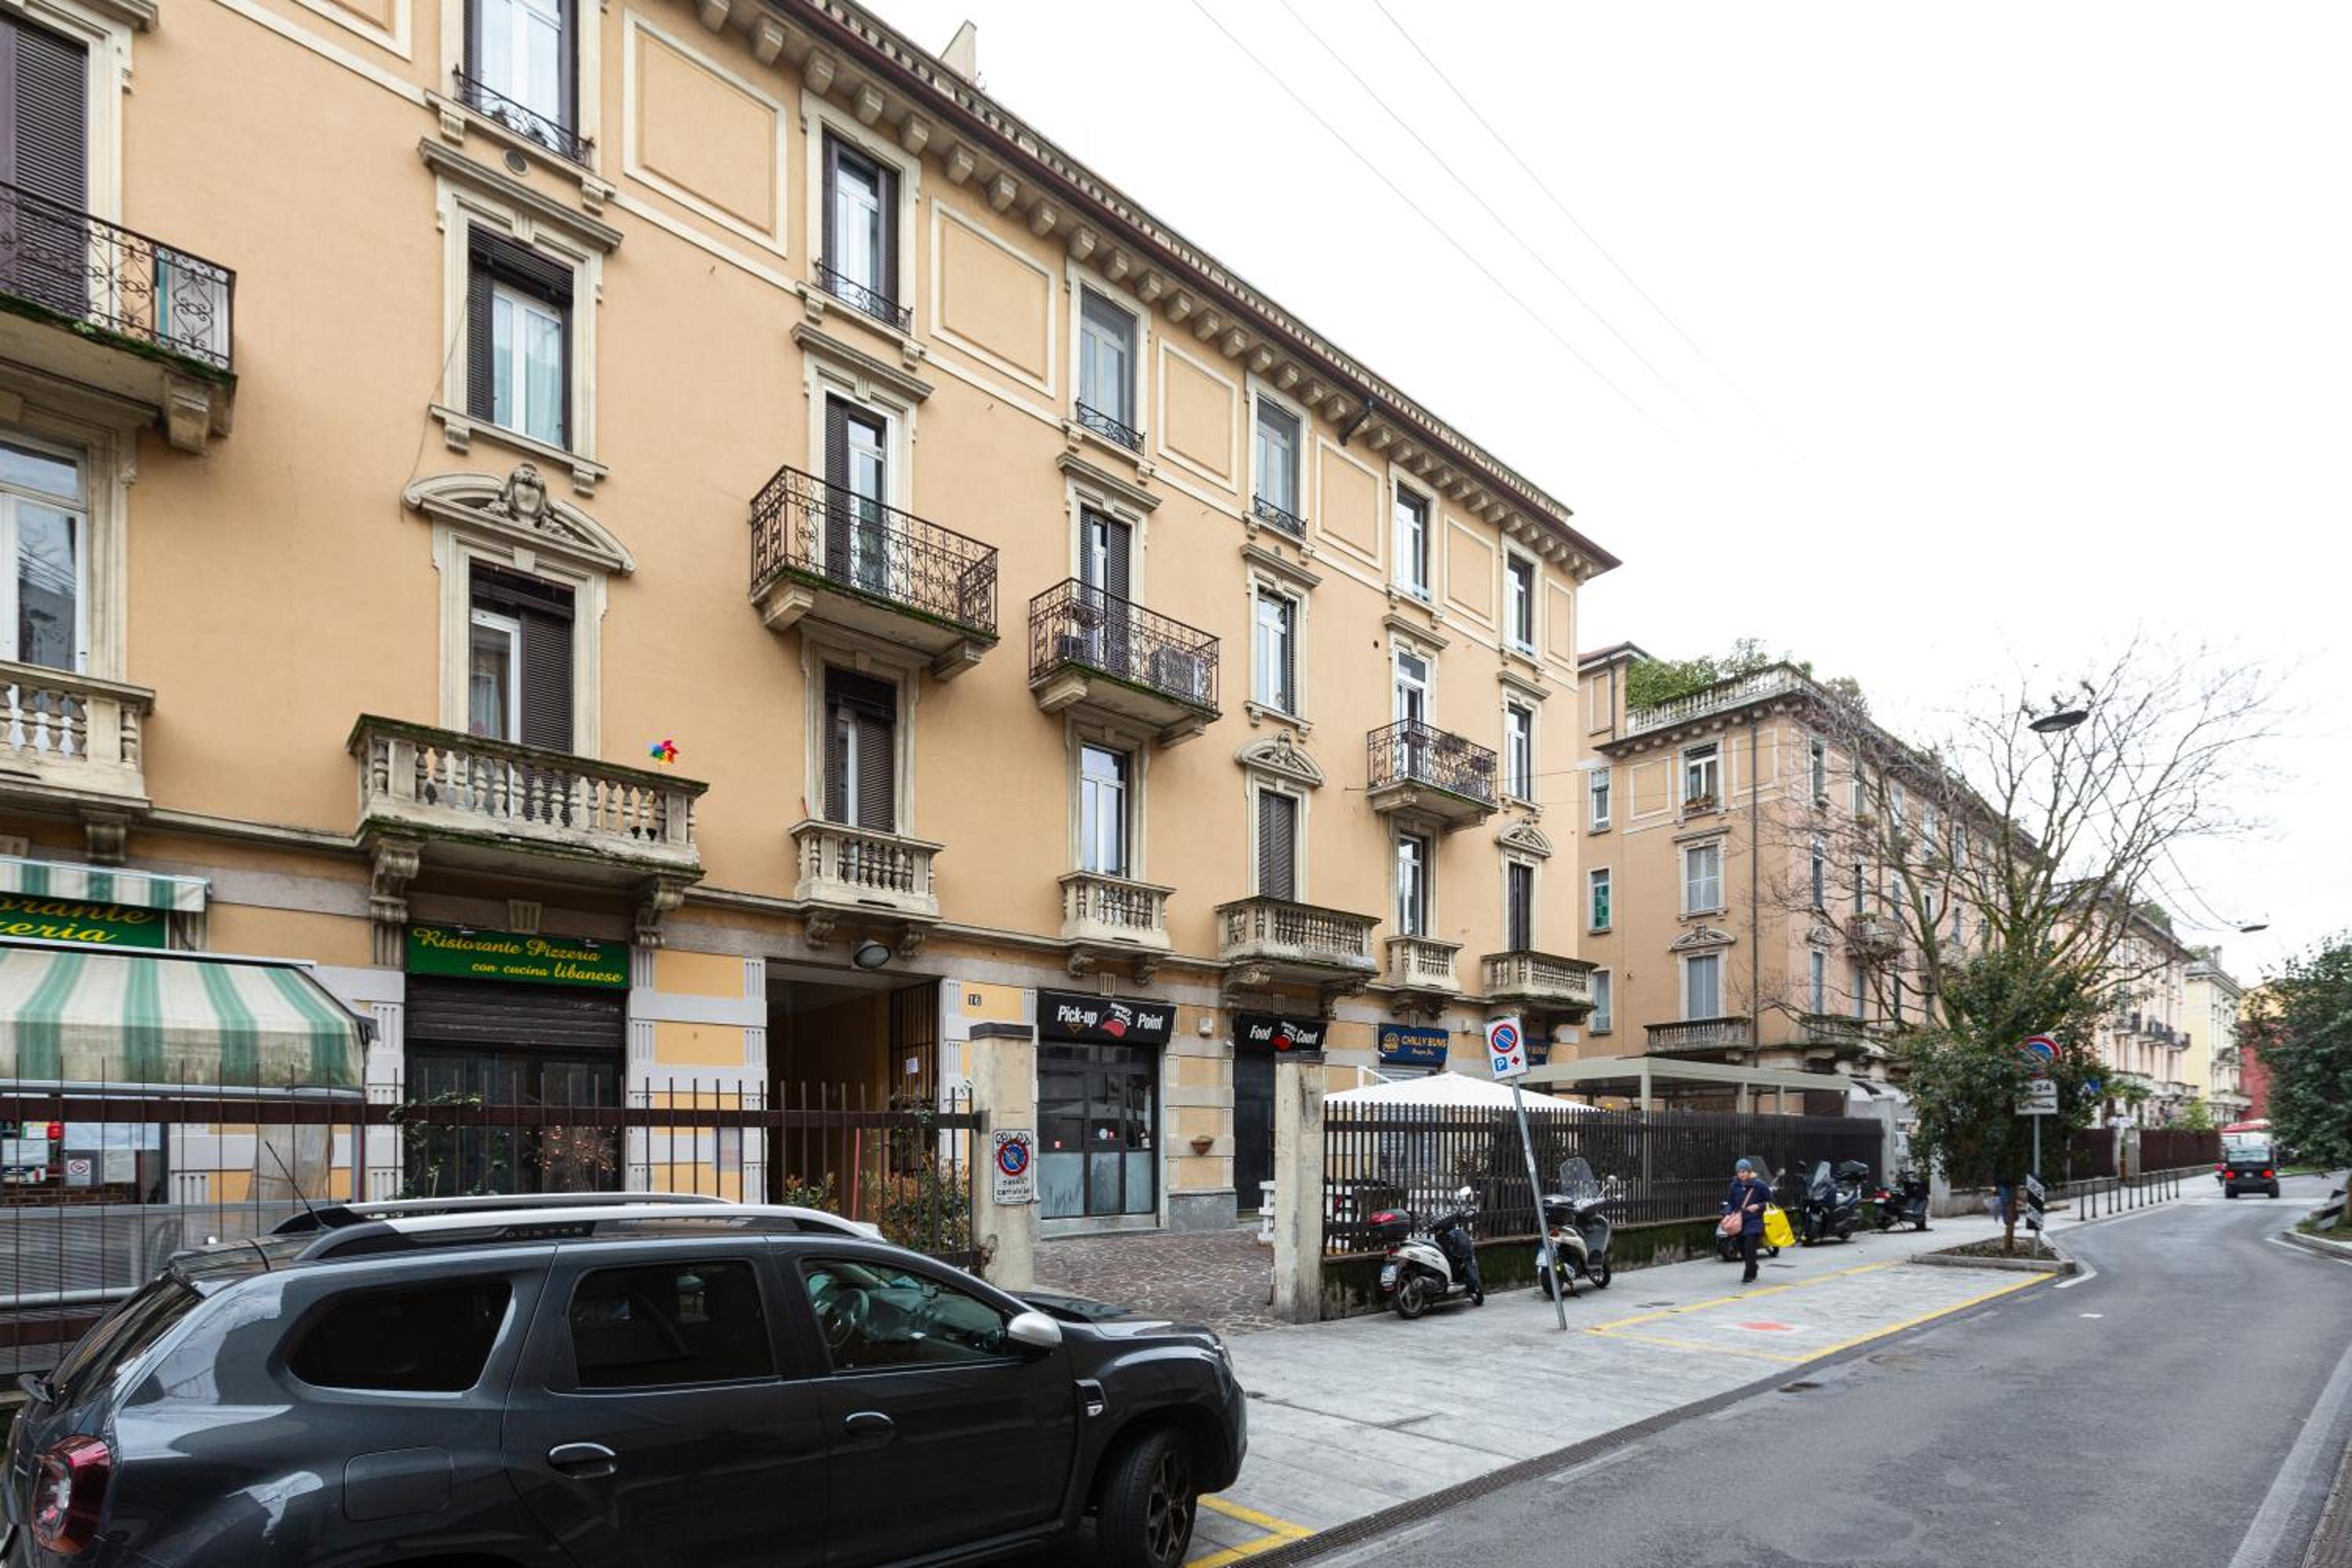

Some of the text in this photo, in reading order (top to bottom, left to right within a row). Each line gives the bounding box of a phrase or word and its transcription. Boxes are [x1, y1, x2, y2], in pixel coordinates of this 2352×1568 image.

[413, 927, 601, 962] Ristorante Pizzeria
[471, 962, 623, 983] con cucina libanese
[1058, 1004, 1098, 1028] Pick-up
[1138, 1012, 1163, 1030] Point
[1249, 1024, 1272, 1040] Food
